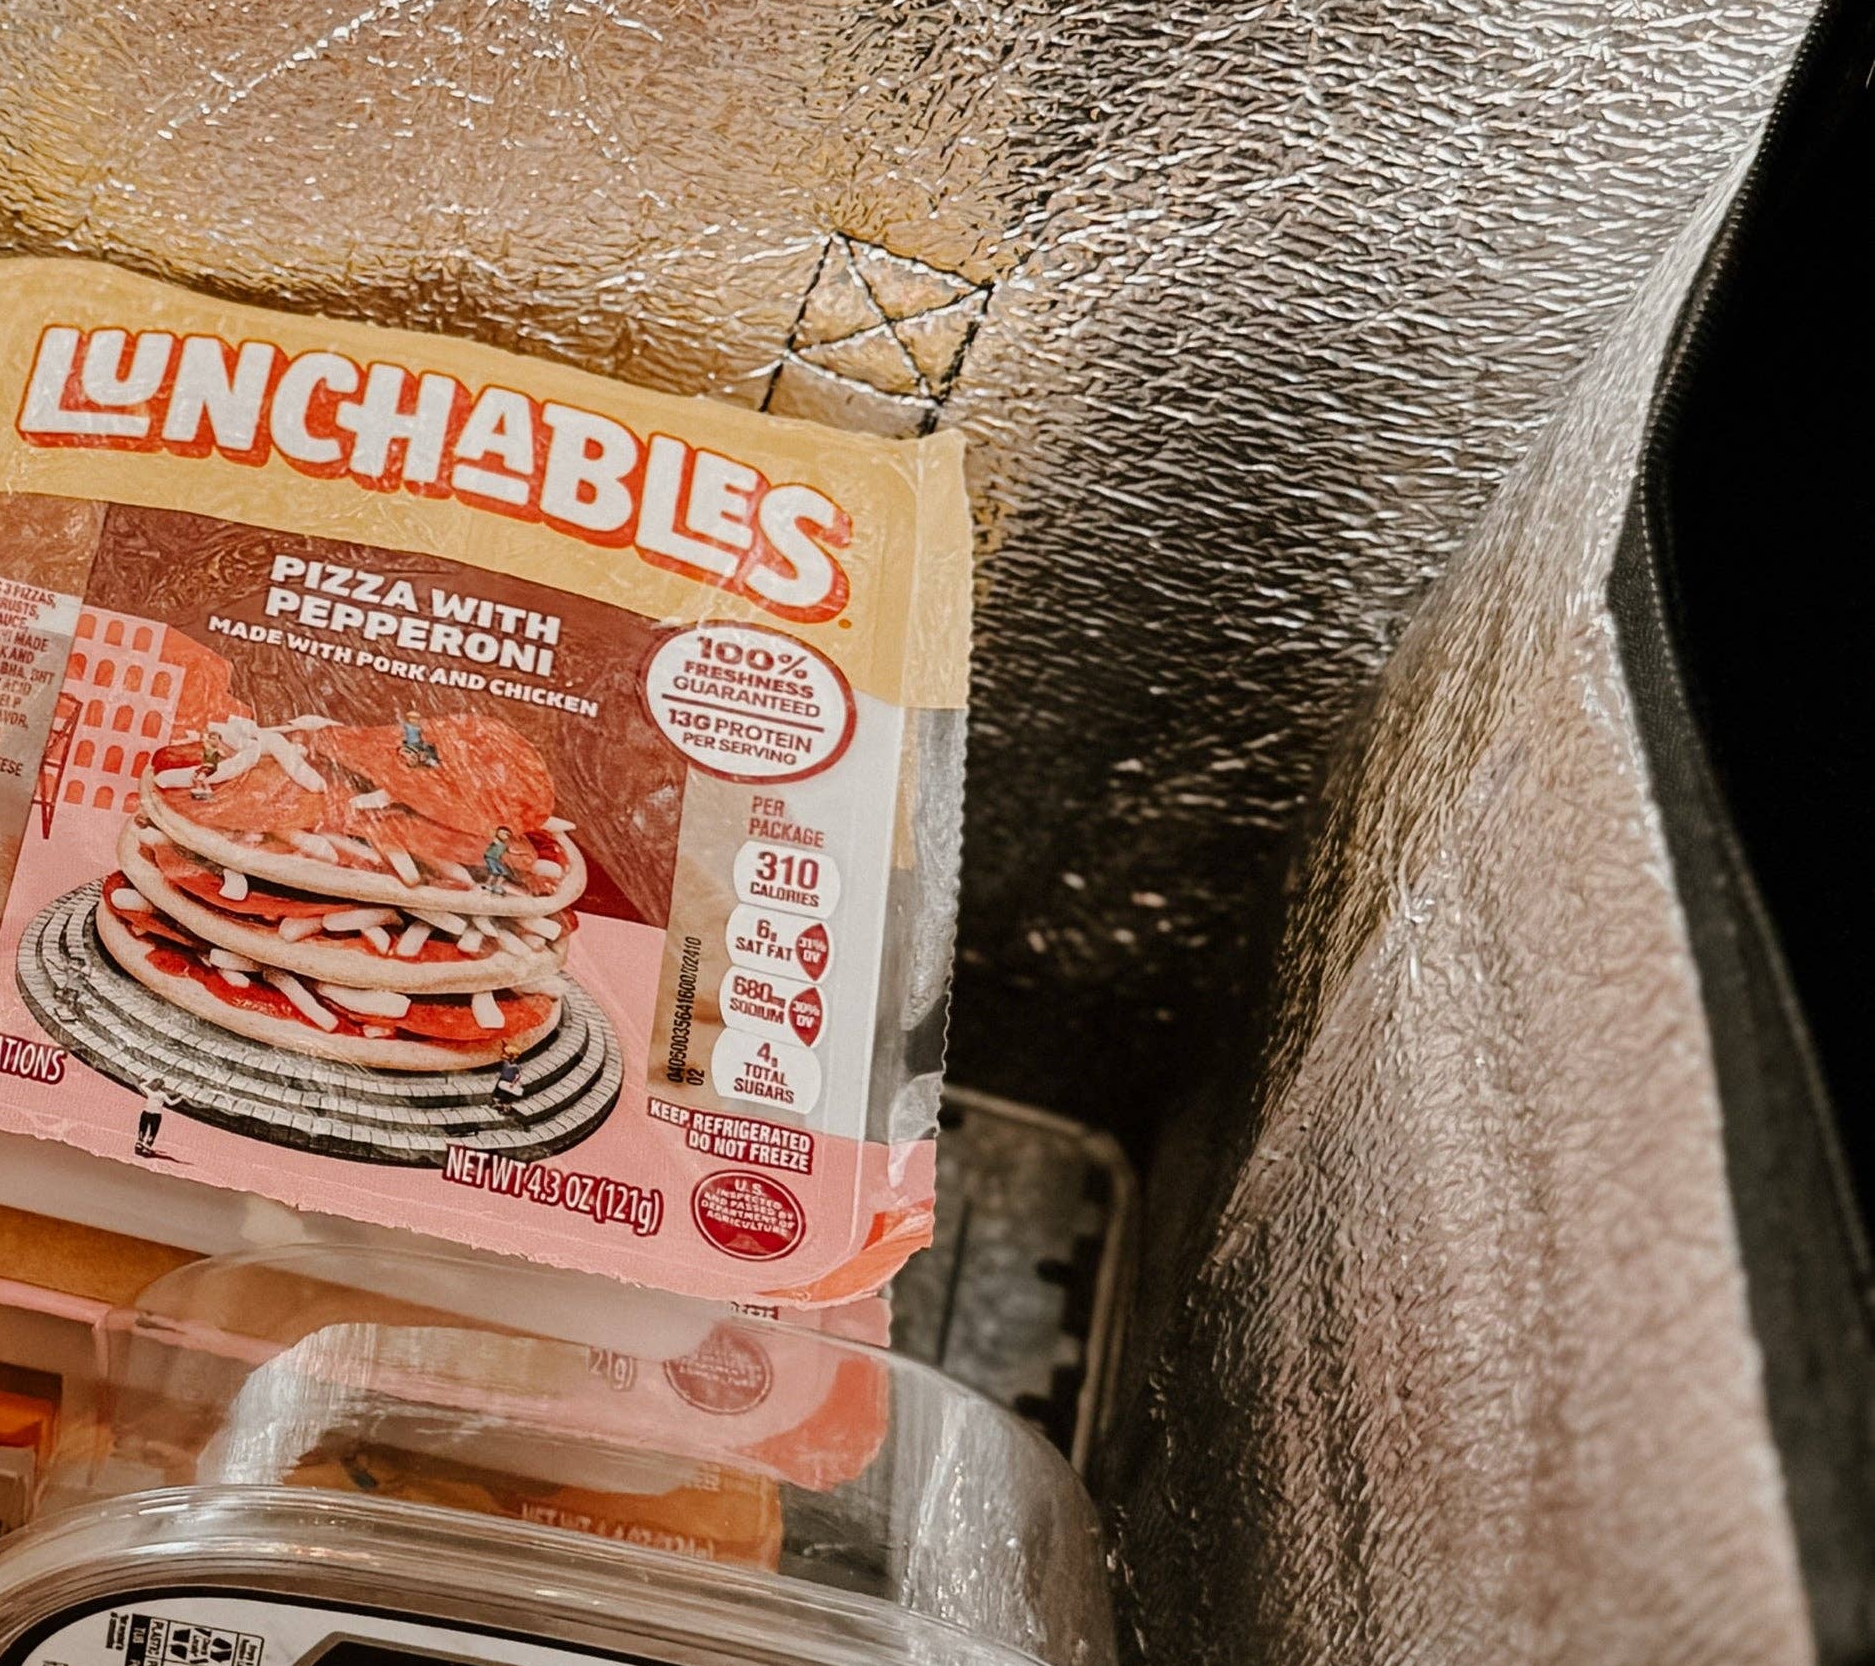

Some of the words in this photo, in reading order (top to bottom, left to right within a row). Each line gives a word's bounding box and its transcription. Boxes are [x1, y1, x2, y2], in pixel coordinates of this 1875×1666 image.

[18, 325, 853, 621] LUNCHABLES
[3, 583, 12, 594] 3
[14, 584, 56, 609] PIZZAS,
[269, 554, 419, 613] PIZZA
[431, 587, 561, 646] WITH
[14, 633, 49, 652] MADE
[264, 586, 554, 677] PEPPERONI
[8, 647, 35, 664] AND
[207, 615, 283, 646] MADE
[286, 633, 352, 664] WITH
[356, 652, 426, 681] PORK
[429, 667, 485, 691] AND
[488, 678, 599, 718] CHICKEN
[696, 635, 809, 680] 100%
[2, 678, 32, 696] ACID
[684, 661, 815, 699] FRESHNESS
[673, 676, 820, 718] GUARANTEED
[669, 707, 712, 731] 13G
[714, 713, 813, 753] PROTEIN
[682, 732, 716, 749] PER
[719, 737, 797, 766] SERVING
[751, 795, 785, 817] PER
[748, 817, 824, 849] PACKAGE
[756, 851, 819, 890] 310
[749, 882, 819, 908] CALORIES
[735, 937, 763, 955] SAT
[767, 945, 793, 961] FAT
[803, 951, 821, 963] DV
[730, 997, 784, 1024] SODIUM
[796, 1014, 814, 1028] DV
[744, 1062, 788, 1086] TOTAL
[734, 1078, 794, 1104] SUGARS
[648, 1099, 689, 1126] KEEP
[693, 1114, 810, 1152] REFRIGERATED
[688, 1132, 711, 1151] DO
[713, 1139, 747, 1160] NOT
[750, 1143, 809, 1172] FREEZE
[447, 1146, 488, 1184] NET
[492, 1155, 526, 1194] WT
[527, 1168, 560, 1203] 4.3
[566, 1176, 594, 1211] OZ
[595, 1181, 660, 1234] (121g)
[704, 1192, 727, 1205] AND
[730, 1200, 775, 1215] PASSED
[716, 1188, 782, 1210] INSPECTED
[701, 1199, 777, 1224] DEPARTMENT
[706, 1210, 788, 1237] AGRICULTURE
[149, 1621, 164, 1659] PLASTIC
